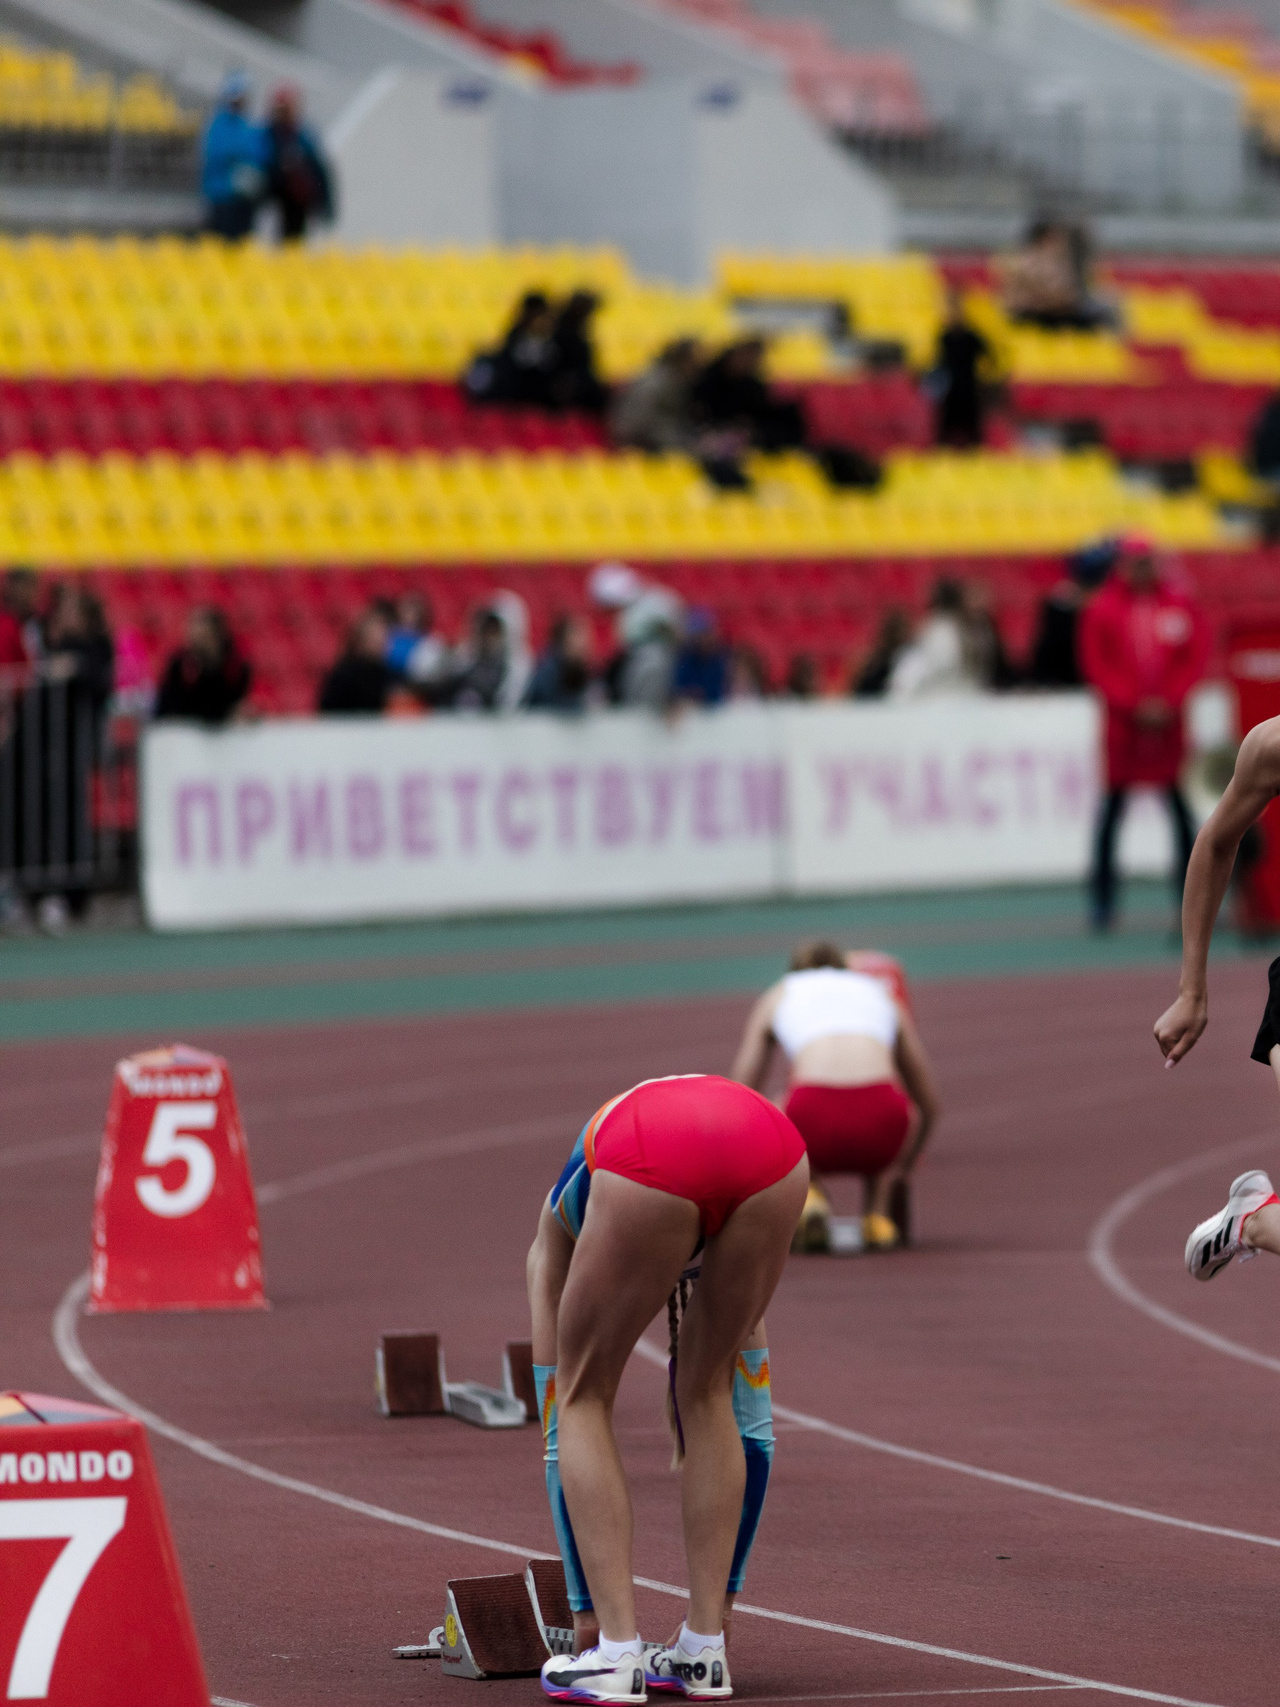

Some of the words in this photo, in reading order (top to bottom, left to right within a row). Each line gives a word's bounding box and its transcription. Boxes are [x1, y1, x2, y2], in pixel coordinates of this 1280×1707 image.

[174, 758, 788, 867] ПРИВЕТСТВУЕМ
[135, 1100, 218, 1219] 5
[0, 1497, 128, 1699] 7
